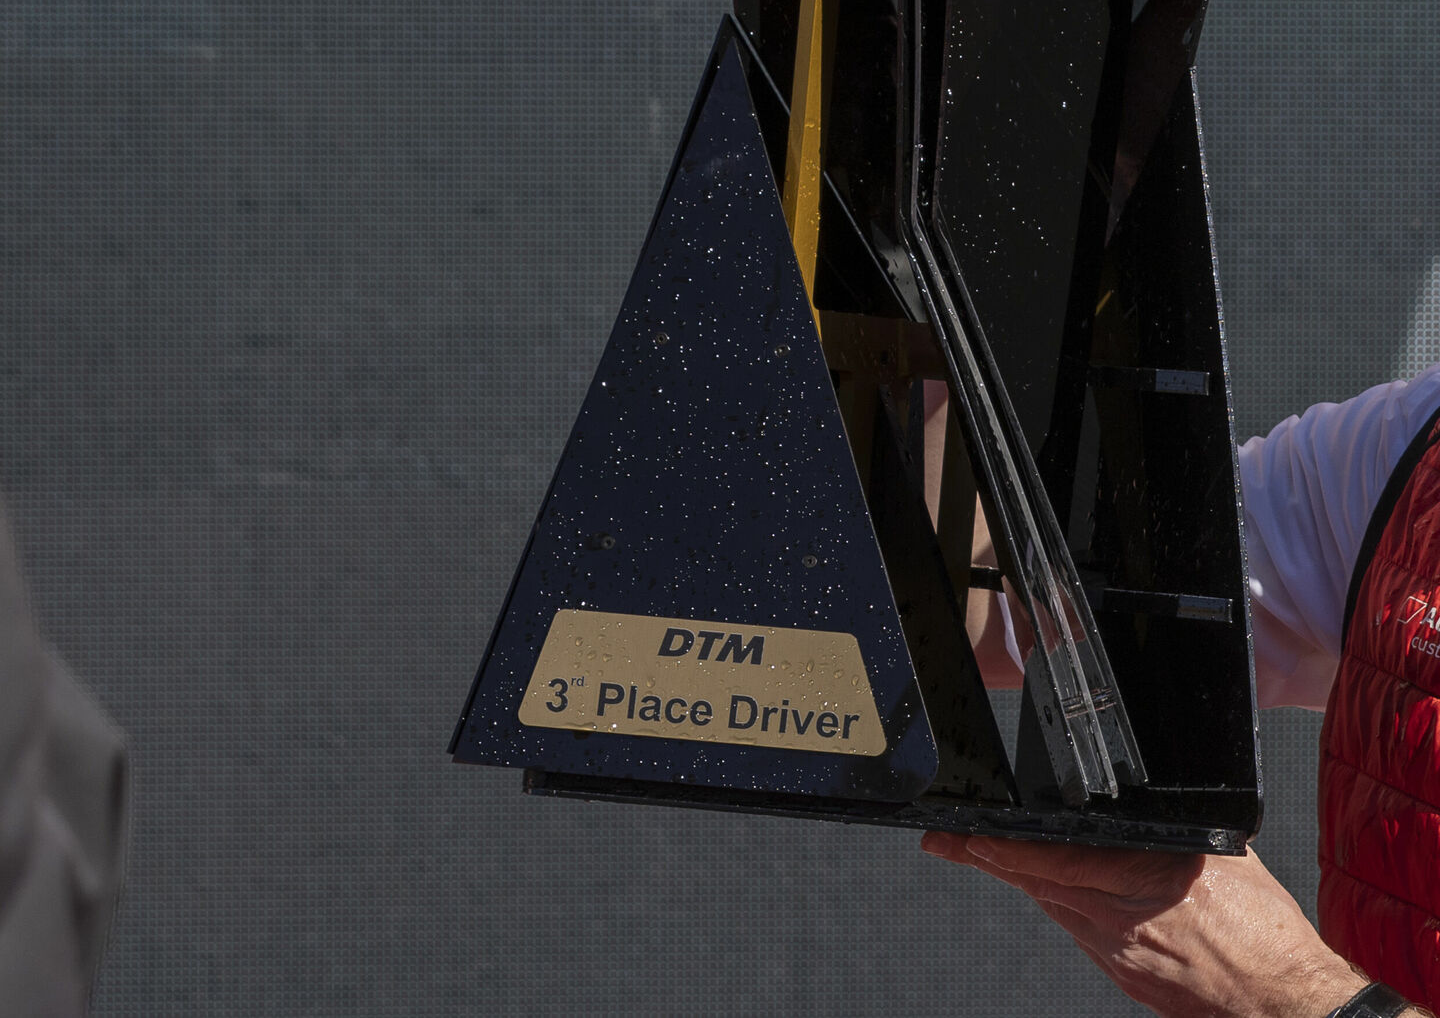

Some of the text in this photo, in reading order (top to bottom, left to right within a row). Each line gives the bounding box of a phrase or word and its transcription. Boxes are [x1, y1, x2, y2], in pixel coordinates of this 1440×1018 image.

[657, 628, 765, 665] DTM
[597, 682, 713, 726] Place
[728, 695, 859, 739] Driver
